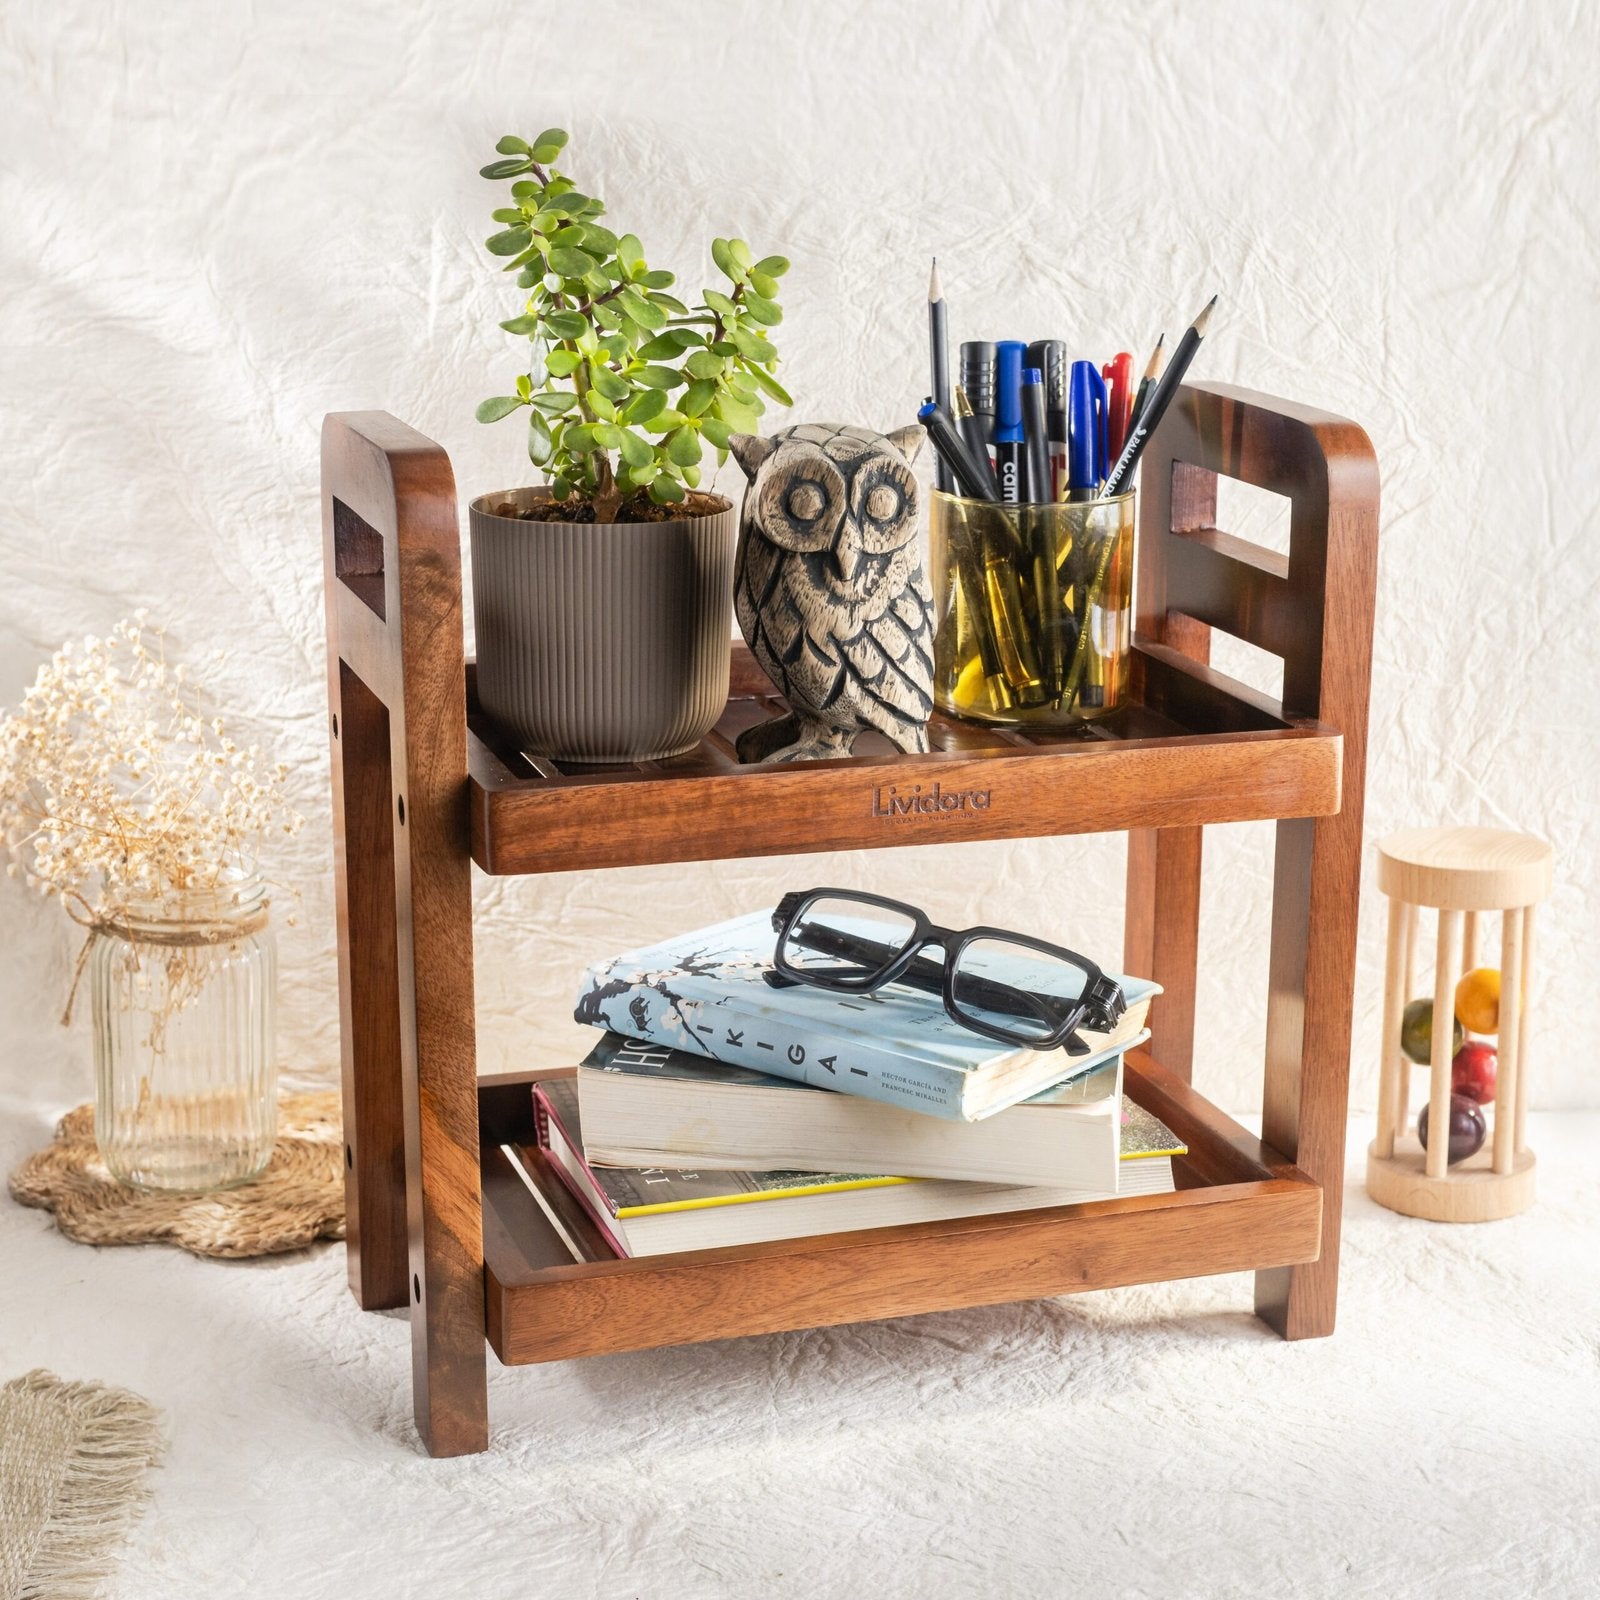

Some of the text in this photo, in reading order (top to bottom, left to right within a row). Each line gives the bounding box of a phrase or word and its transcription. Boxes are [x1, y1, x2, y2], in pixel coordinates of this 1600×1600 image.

[1100, 436, 1141, 500] PALM MEADO
[872, 782, 991, 817] Lividora
[697, 1024, 868, 1077] IKIGAI
[933, 1086, 947, 1094] AND
